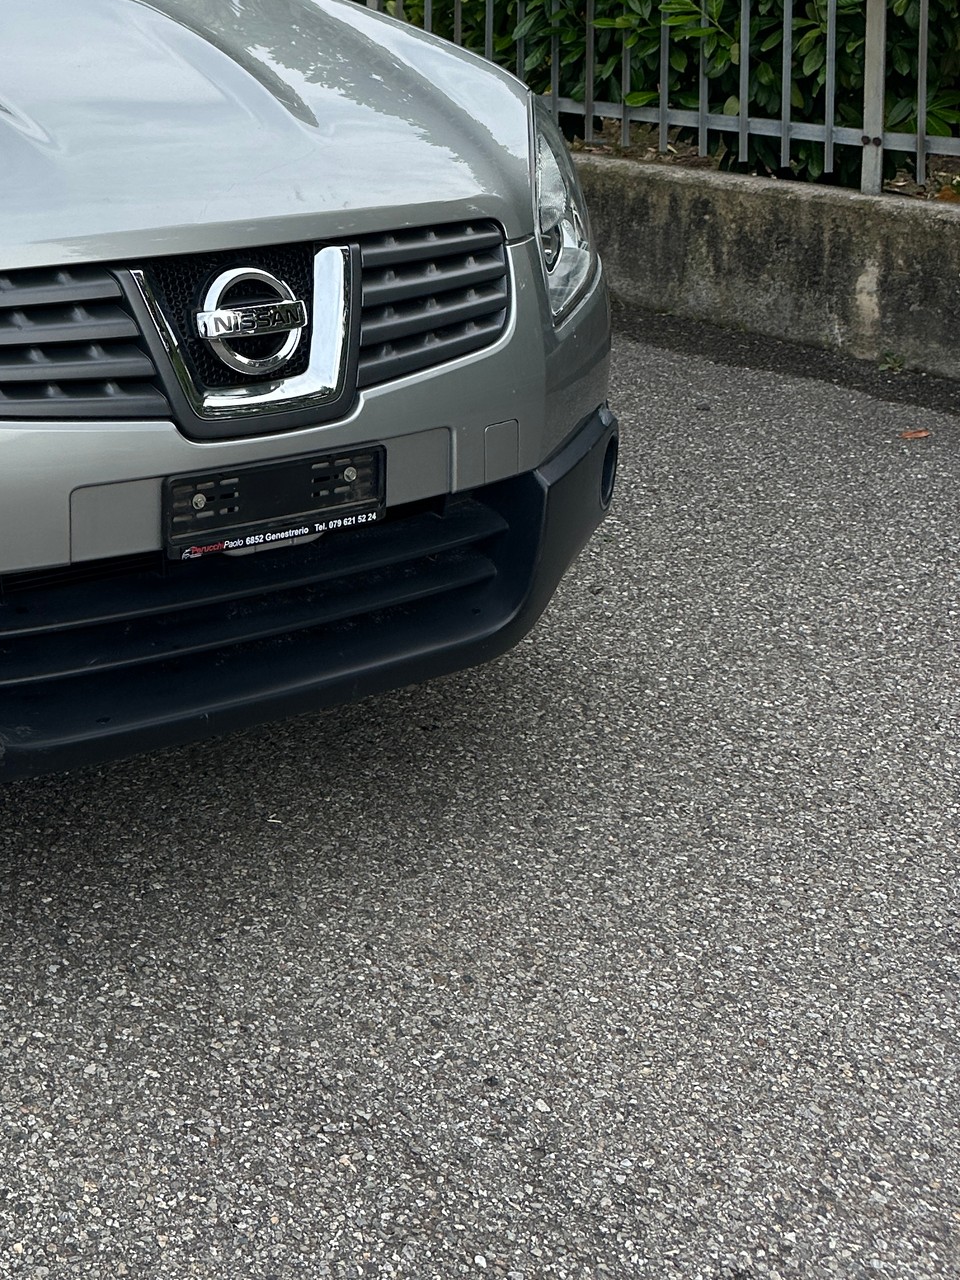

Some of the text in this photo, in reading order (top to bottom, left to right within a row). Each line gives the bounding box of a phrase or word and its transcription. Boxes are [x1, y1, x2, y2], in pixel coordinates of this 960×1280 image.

[213, 304, 301, 332] NISSAN
[245, 534, 264, 545] 6852
[265, 526, 309, 541] Genestrerio
[314, 522, 328, 532] Tel.
[329, 518, 342, 529] 079
[343, 516, 356, 526] 621
[357, 514, 367, 523] 52
[367, 512, 377, 521] 24
